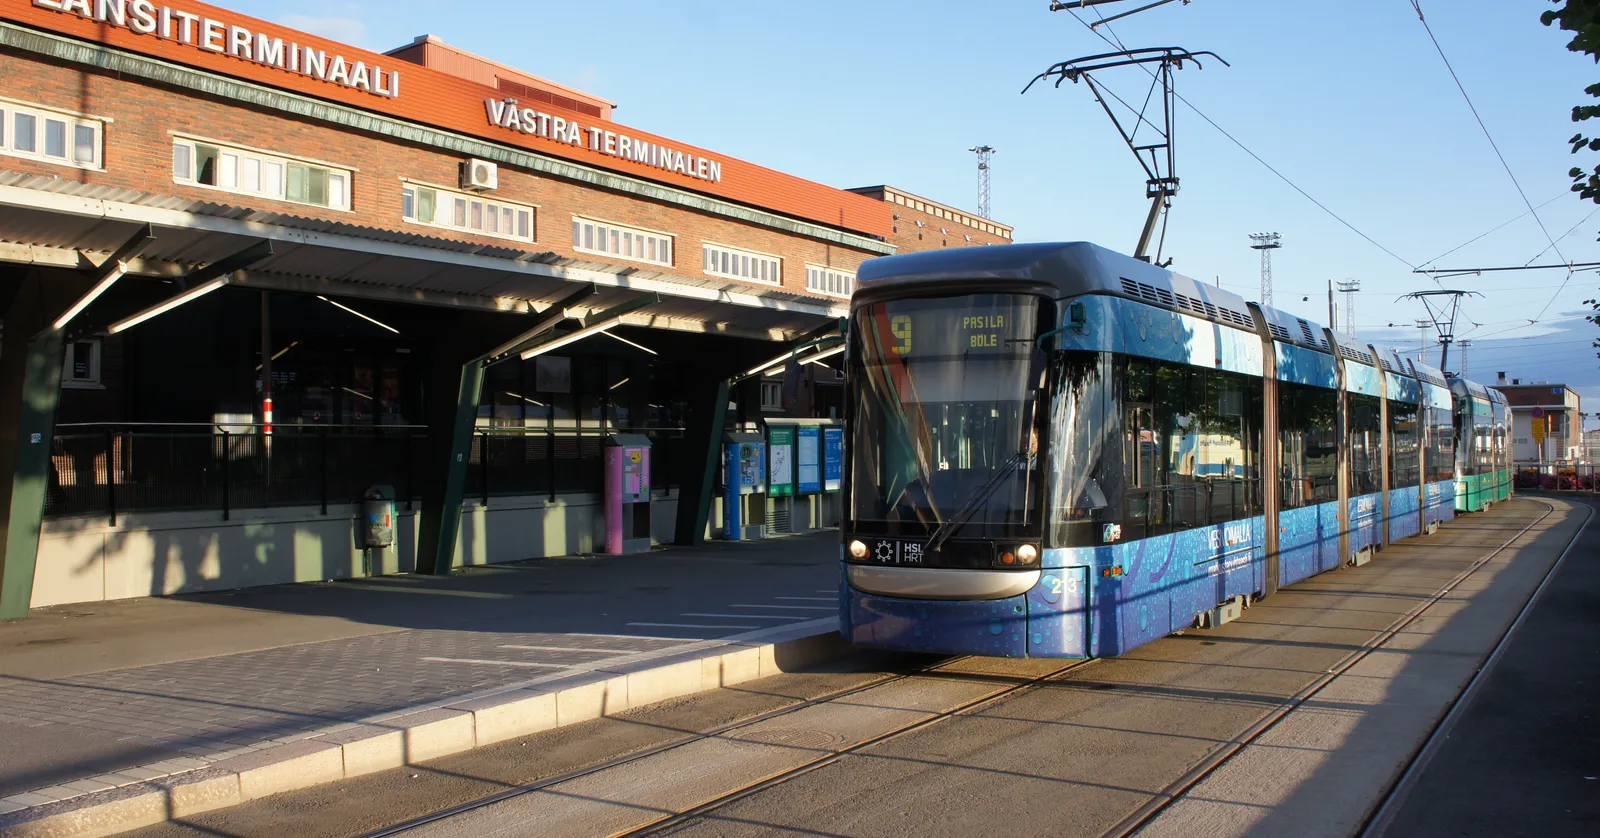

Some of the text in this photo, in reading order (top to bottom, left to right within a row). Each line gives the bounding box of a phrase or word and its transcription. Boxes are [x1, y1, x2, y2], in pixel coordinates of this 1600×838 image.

[484, 98, 722, 182] VÄSTRA TERMINALEN
[963, 315, 1004, 329] PASILA
[891, 315, 912, 354] 9
[970, 333, 997, 348] BÖLE
[904, 552, 925, 563] HRT
[1051, 577, 1077, 594] 23
